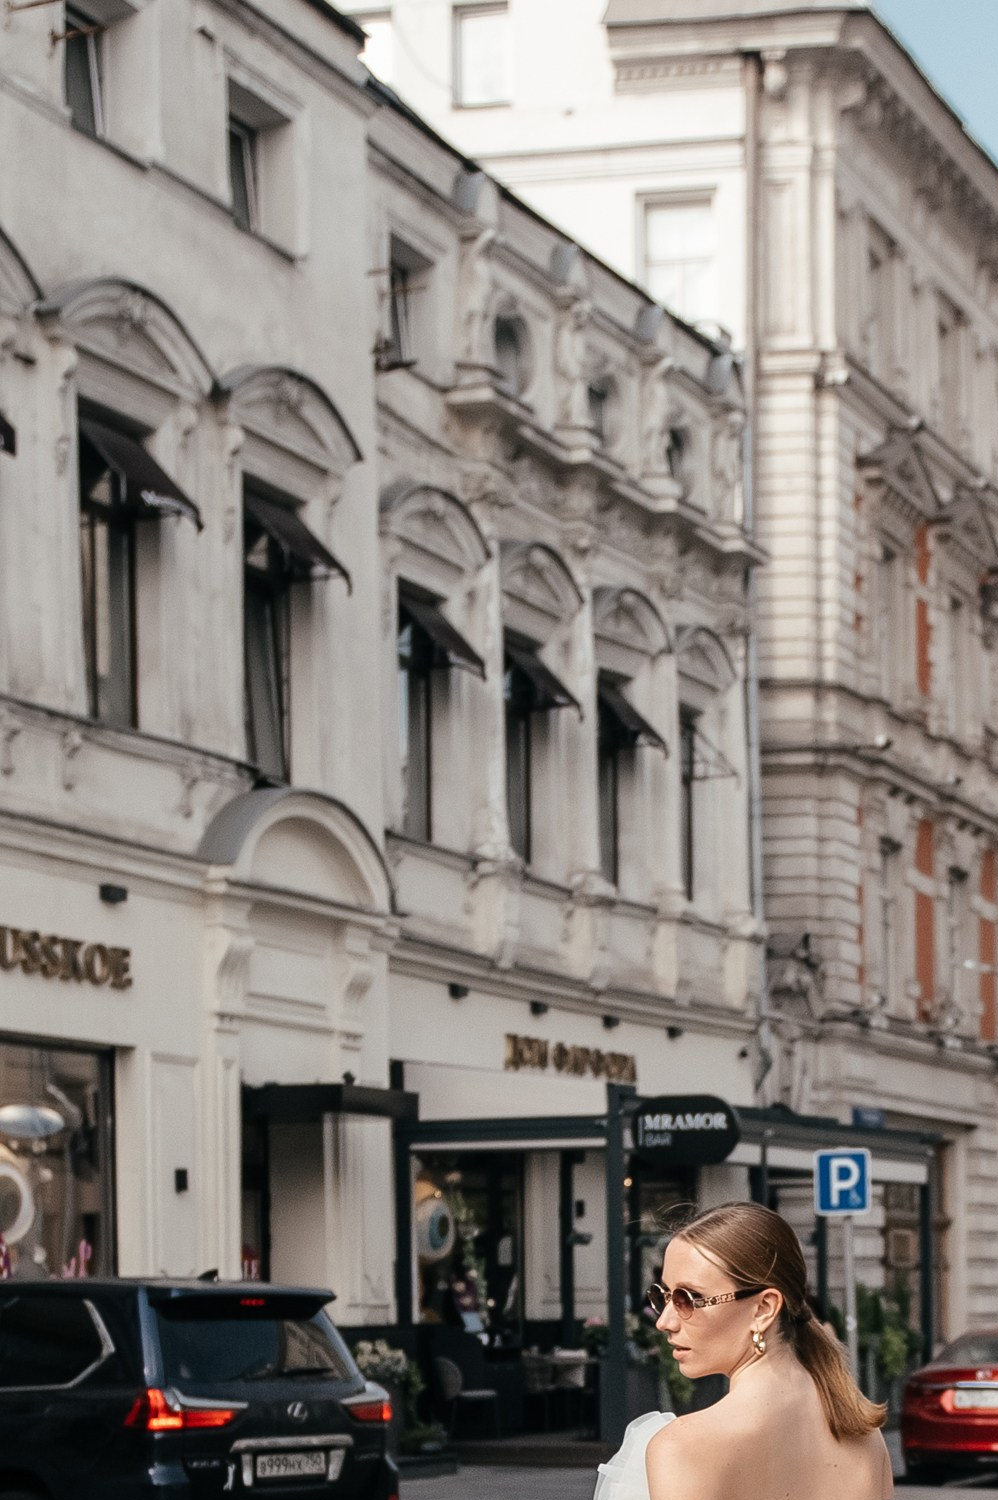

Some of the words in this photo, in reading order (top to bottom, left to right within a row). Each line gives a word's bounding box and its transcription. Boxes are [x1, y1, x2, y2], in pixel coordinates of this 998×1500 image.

[644, 1113, 727, 1131] MRAMOR
[645, 1132, 672, 1147] BAR
[830, 1158, 860, 1208] P
